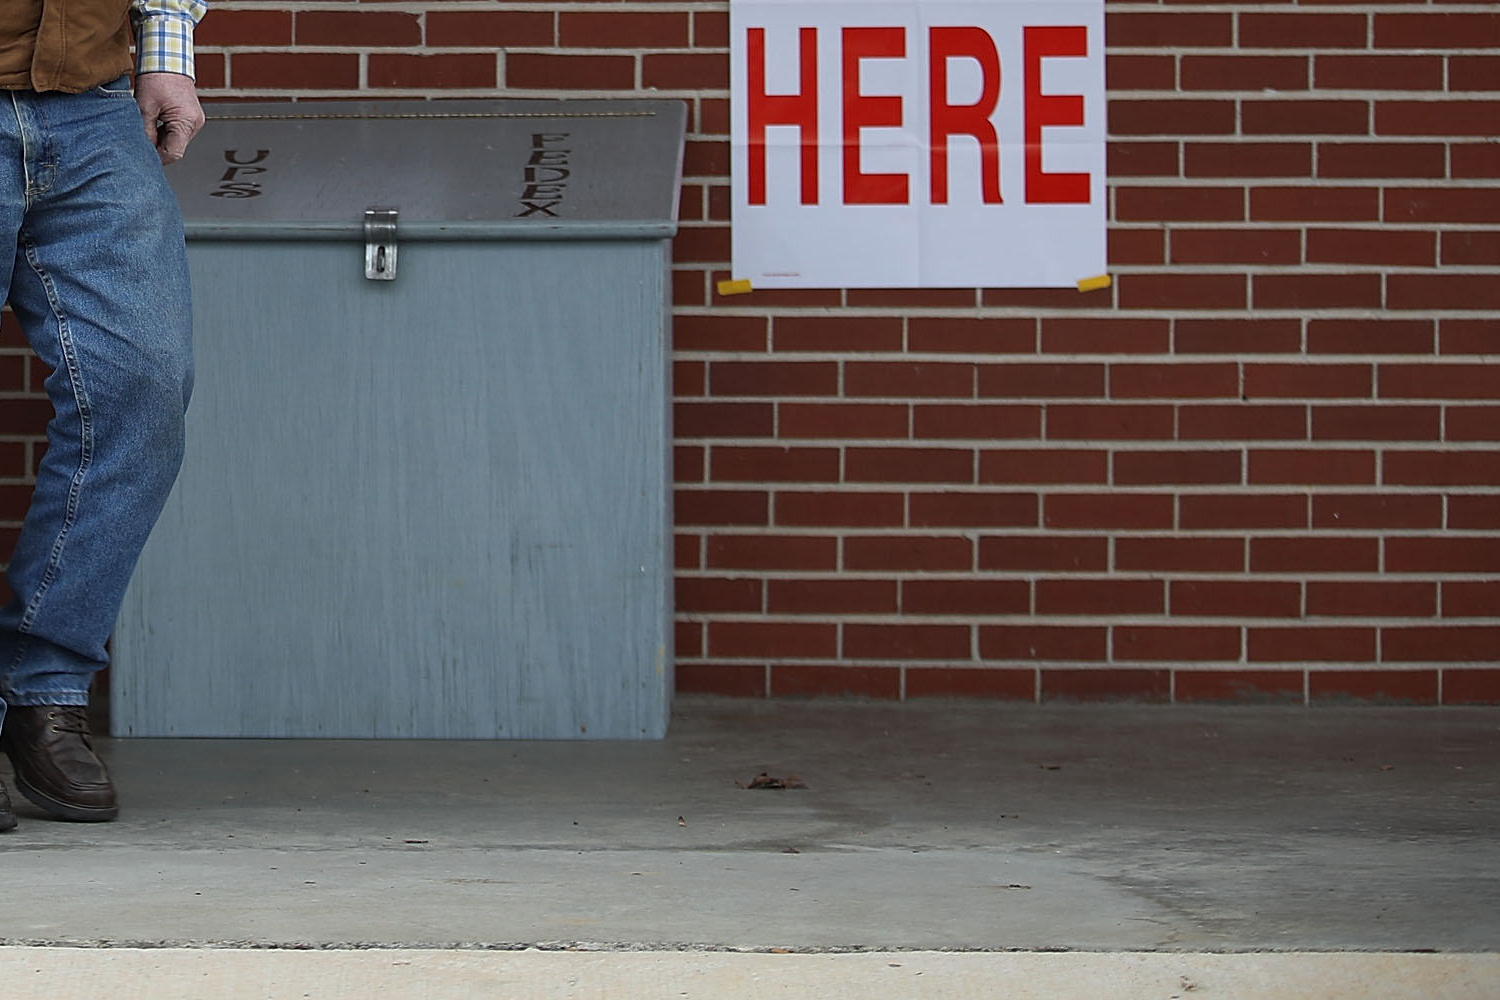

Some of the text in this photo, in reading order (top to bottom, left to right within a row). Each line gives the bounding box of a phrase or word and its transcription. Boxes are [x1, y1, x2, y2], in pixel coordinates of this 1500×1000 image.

[746, 25, 1092, 206] HERE
[209, 150, 269, 199] UPS
[516, 132, 571, 217] FEDEX
